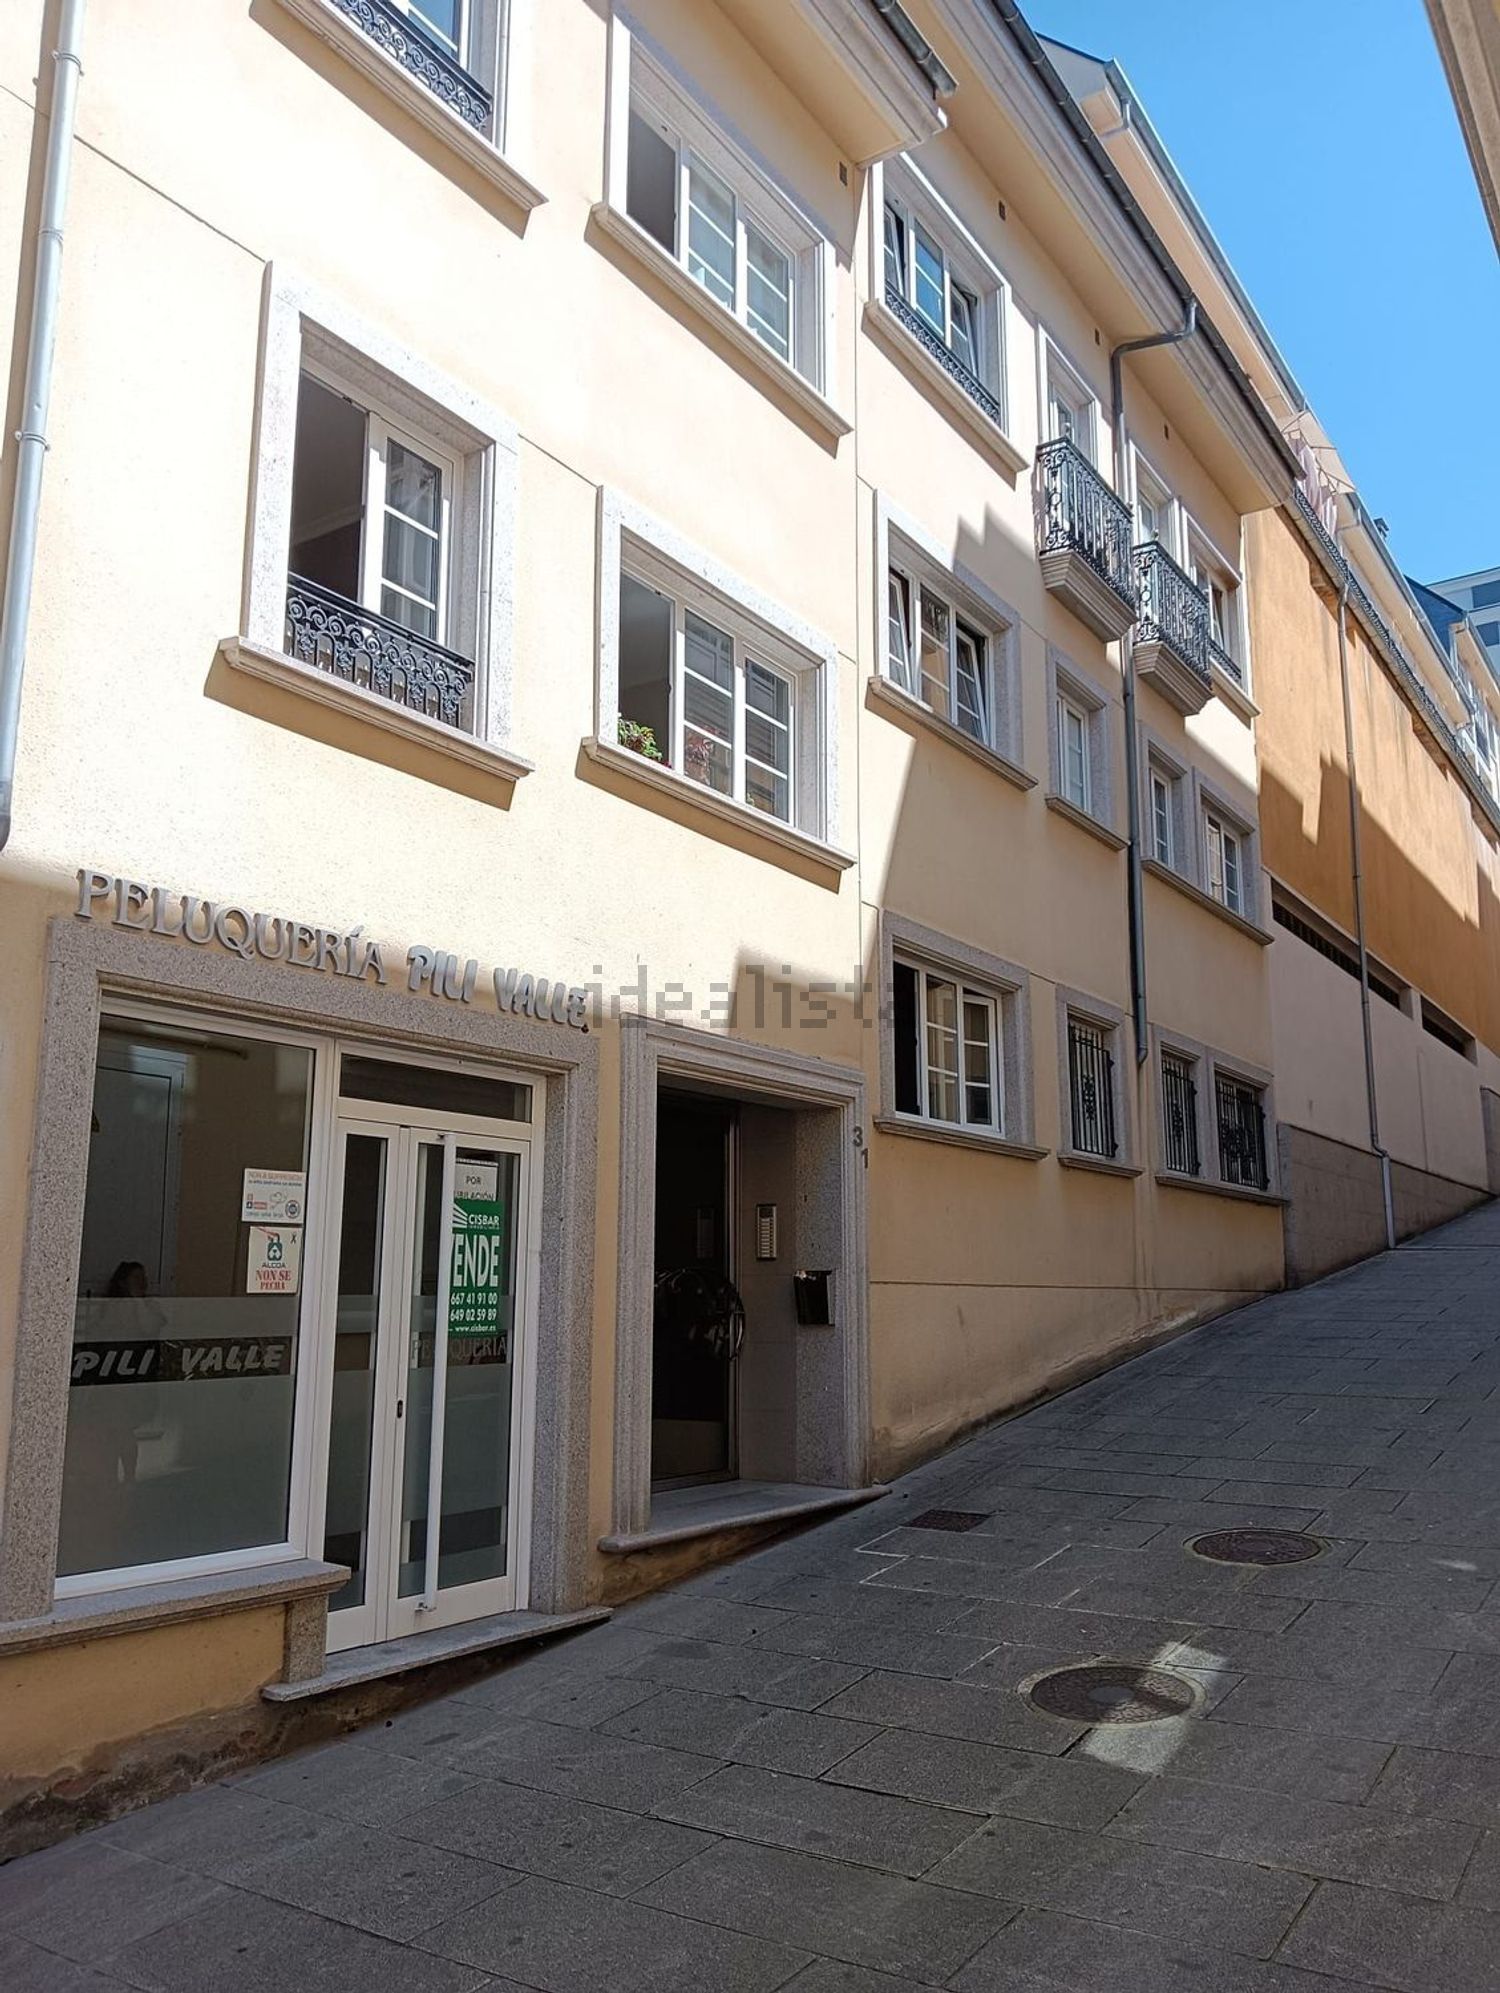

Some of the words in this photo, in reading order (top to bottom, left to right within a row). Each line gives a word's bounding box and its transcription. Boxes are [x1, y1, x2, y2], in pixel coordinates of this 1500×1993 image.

[76, 867, 387, 985] PELUQUERÍA
[407, 943, 477, 1003] PILI
[494, 967, 587, 1028] VALLE
[466, 1175, 482, 1185] POR
[468, 1214, 500, 1226] CISBAR
[453, 1233, 500, 1288] ENDE
[255, 1269, 276, 1281] NON
[279, 1270, 292, 1281] SE
[450, 1292, 465, 1305] 667
[466, 1293, 476, 1305] 41
[477, 1293, 486, 1305] 91
[488, 1293, 498, 1305] 00
[450, 1308, 465, 1321] 649
[465, 1308, 475, 1321] 02
[476, 1308, 487, 1321] 59
[487, 1308, 497, 1321] 89
[72, 1350, 156, 1378] PILI
[181, 1344, 285, 1373] VALLE
